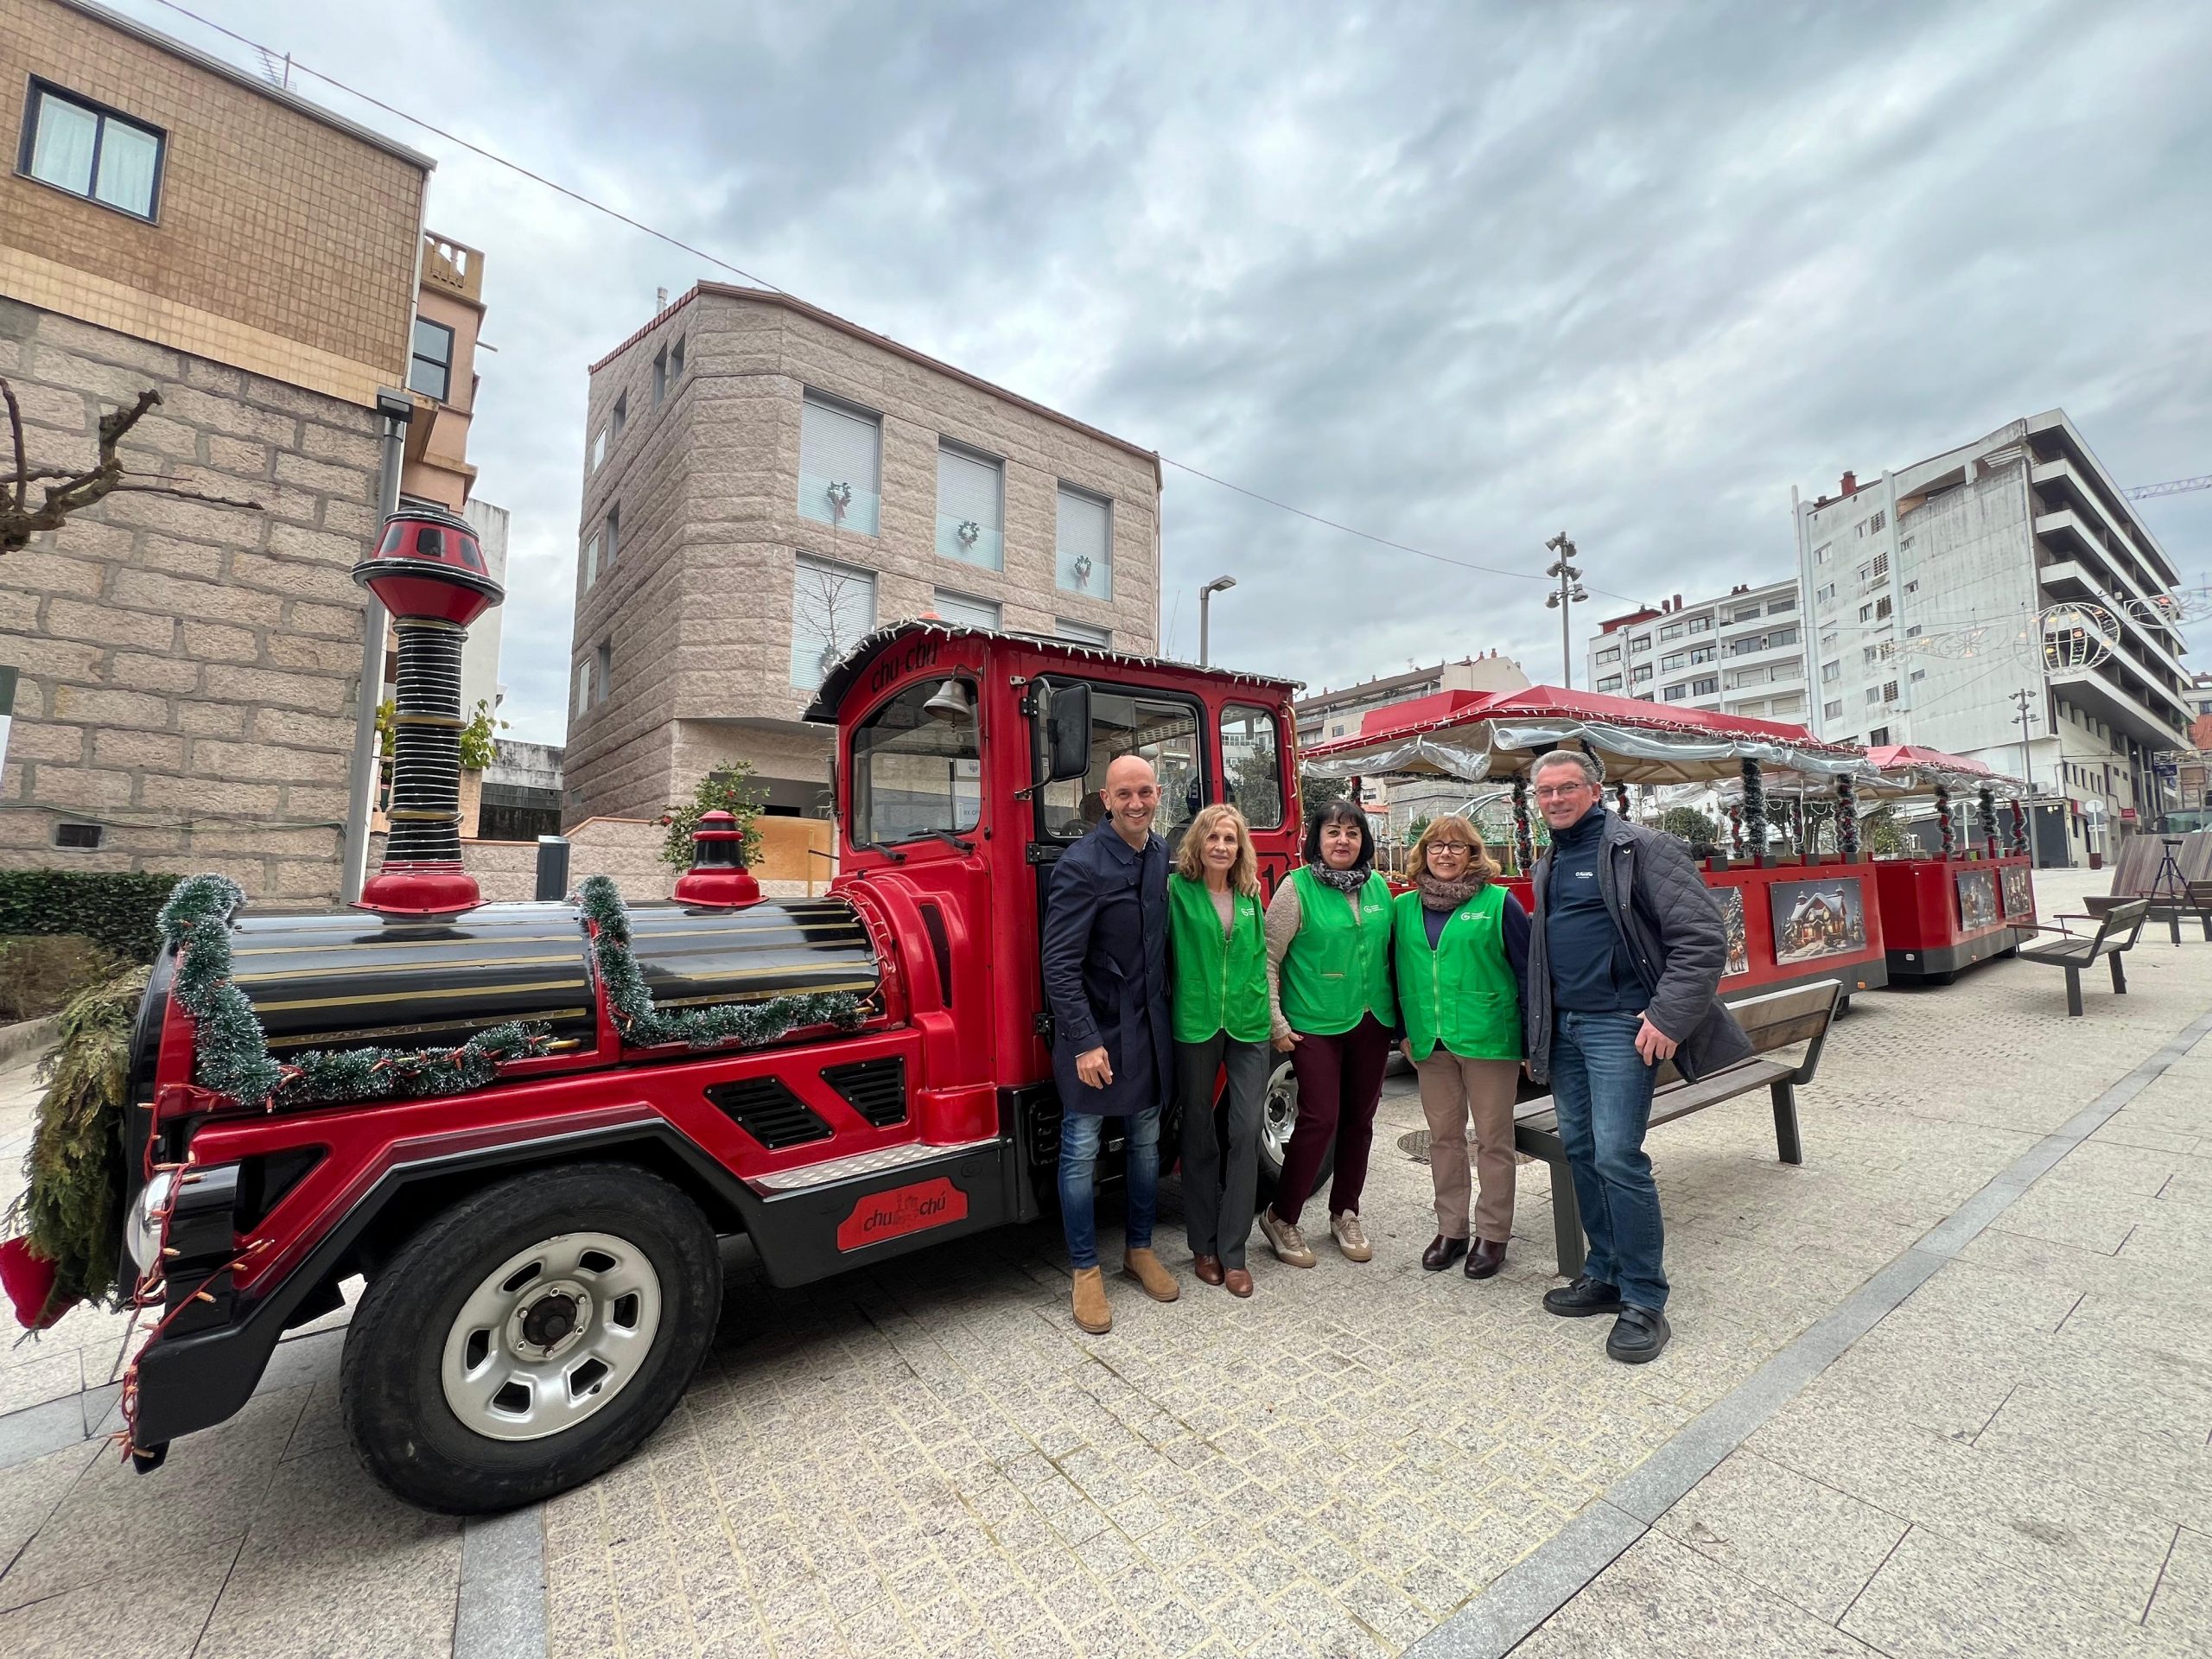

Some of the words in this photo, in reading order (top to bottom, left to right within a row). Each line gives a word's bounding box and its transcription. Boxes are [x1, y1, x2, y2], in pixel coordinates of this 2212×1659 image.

[872, 657, 899, 694] chu
[863, 1209, 892, 1231] chu
[919, 1190, 946, 1215] chú
